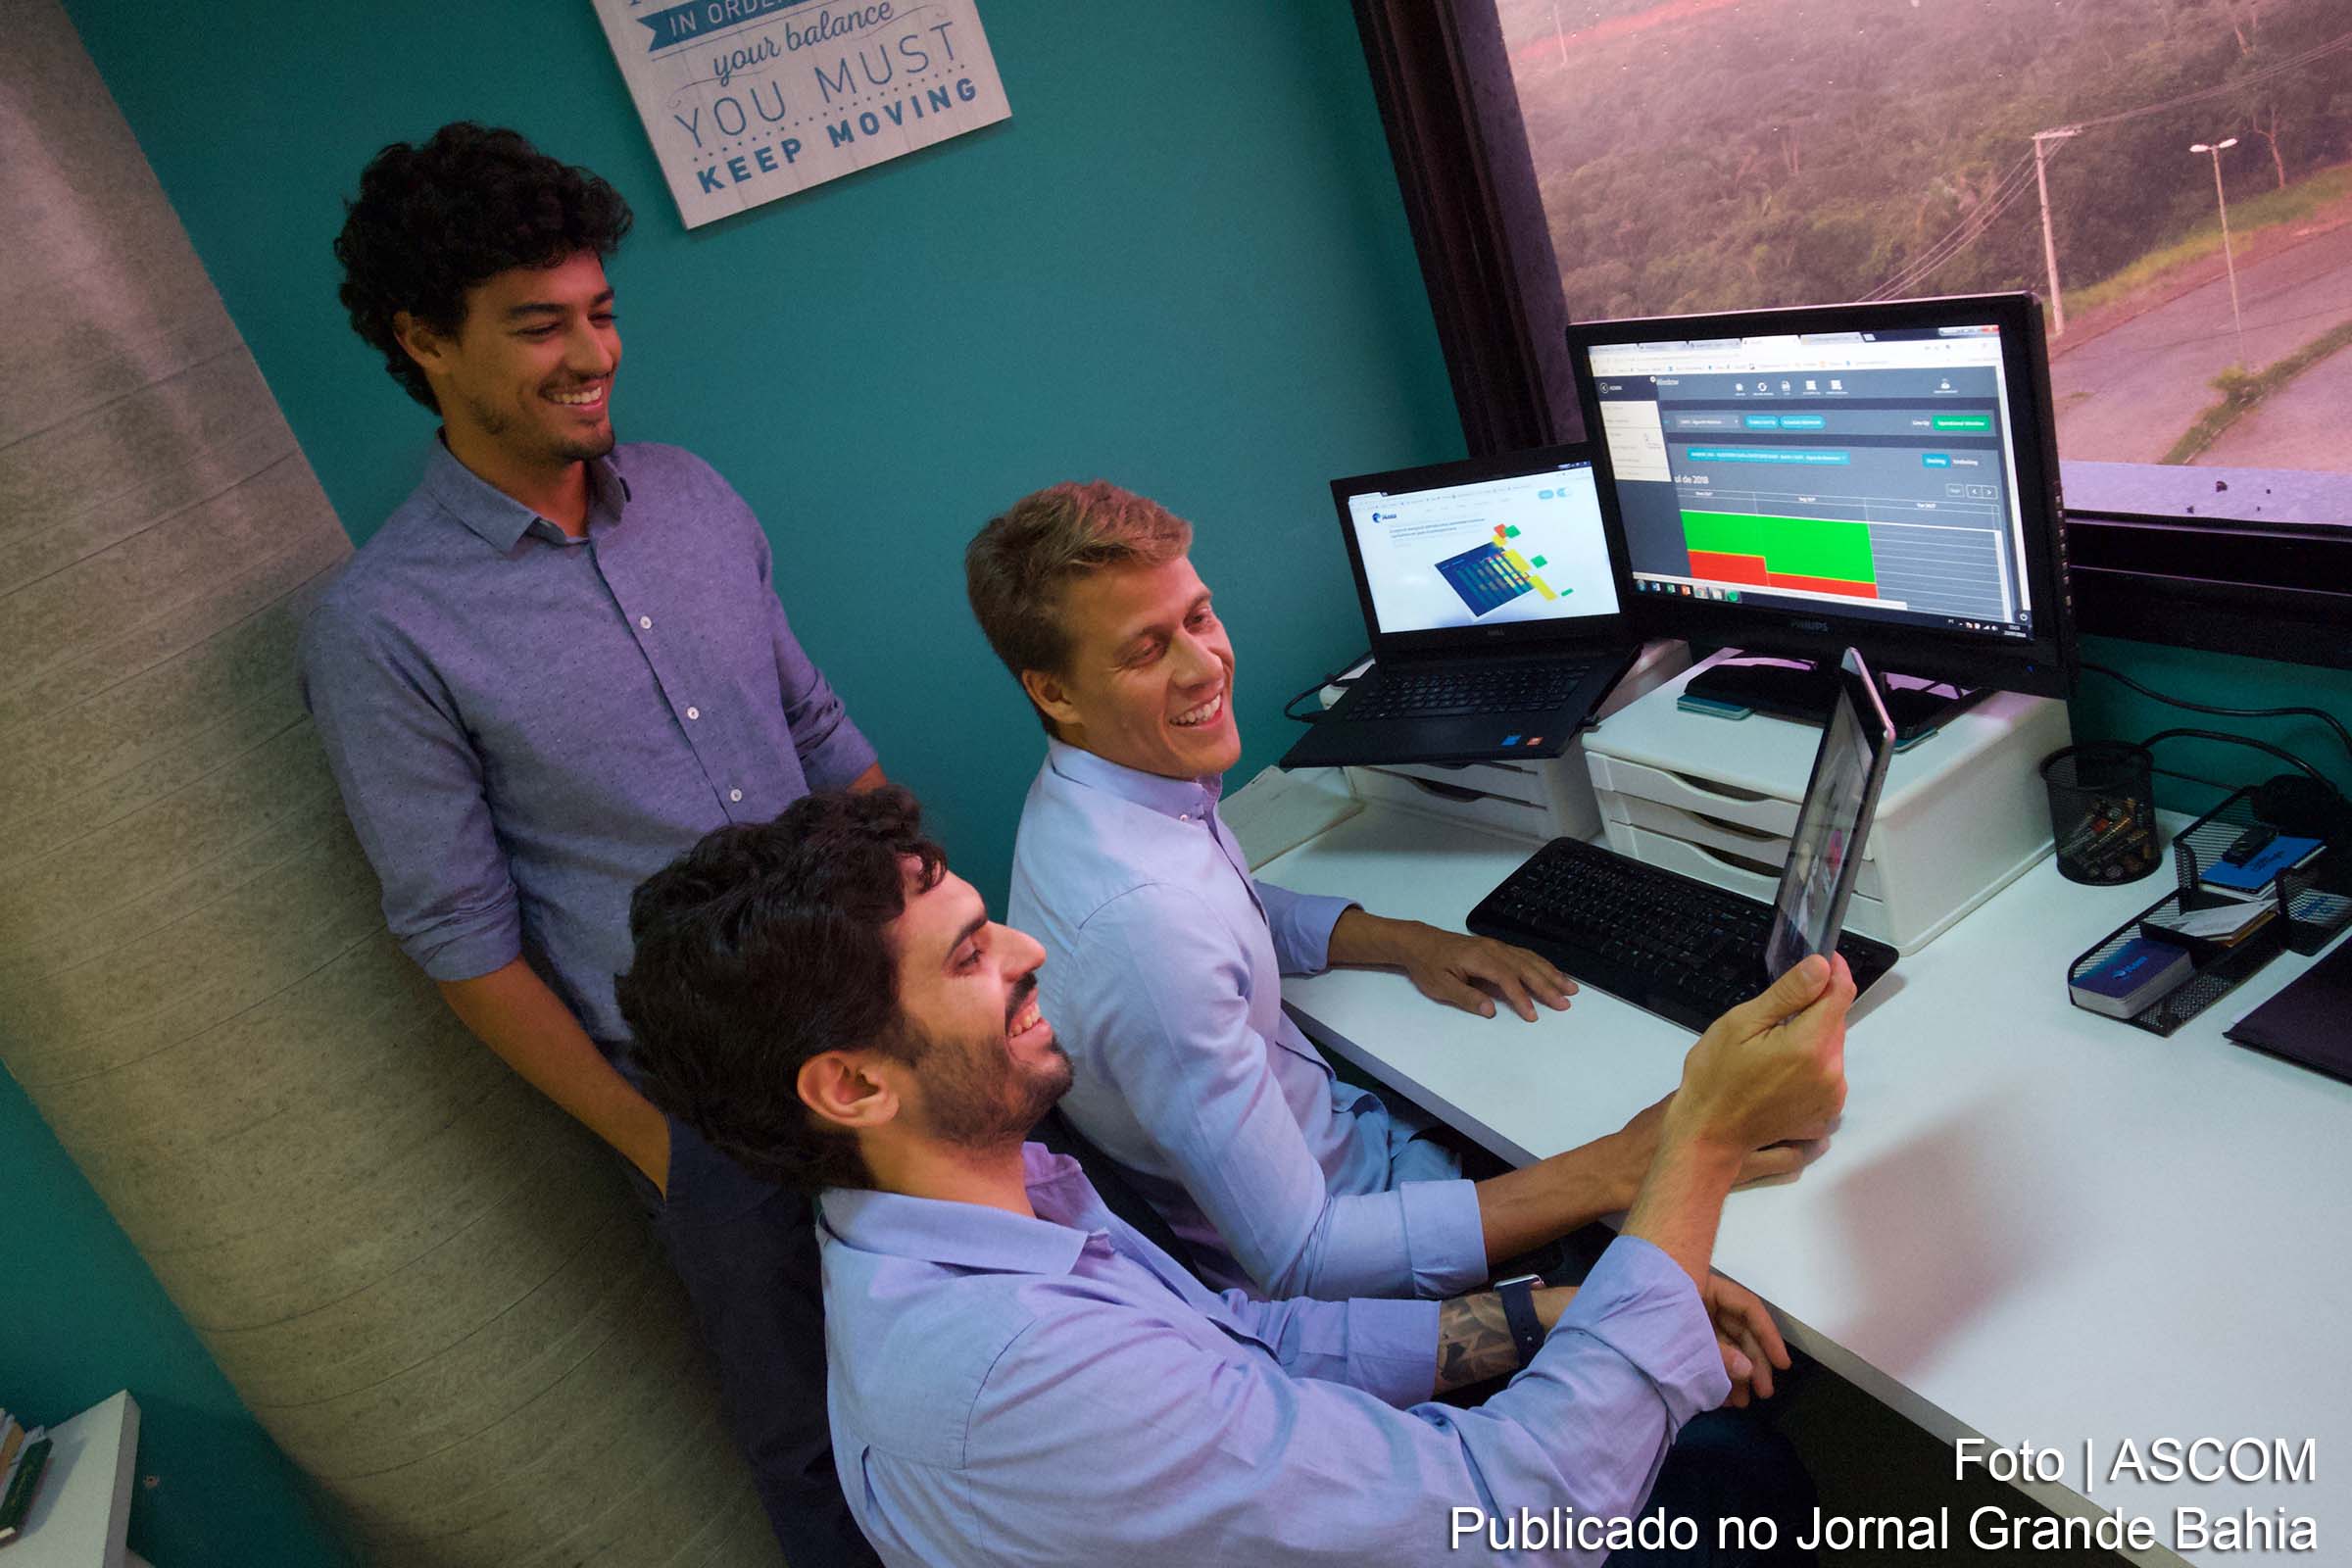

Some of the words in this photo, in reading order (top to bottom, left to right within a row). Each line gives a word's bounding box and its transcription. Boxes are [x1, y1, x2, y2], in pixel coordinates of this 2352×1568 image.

[669, 10, 697, 36] IN
[708, 0, 782, 24] ORD
[713, 36, 781, 87] your
[785, 2, 895, 52] balance
[674, 80, 785, 149] YOU
[813, 22, 956, 104] MUST
[695, 137, 803, 194] KEEP
[826, 77, 977, 149] MOVING
